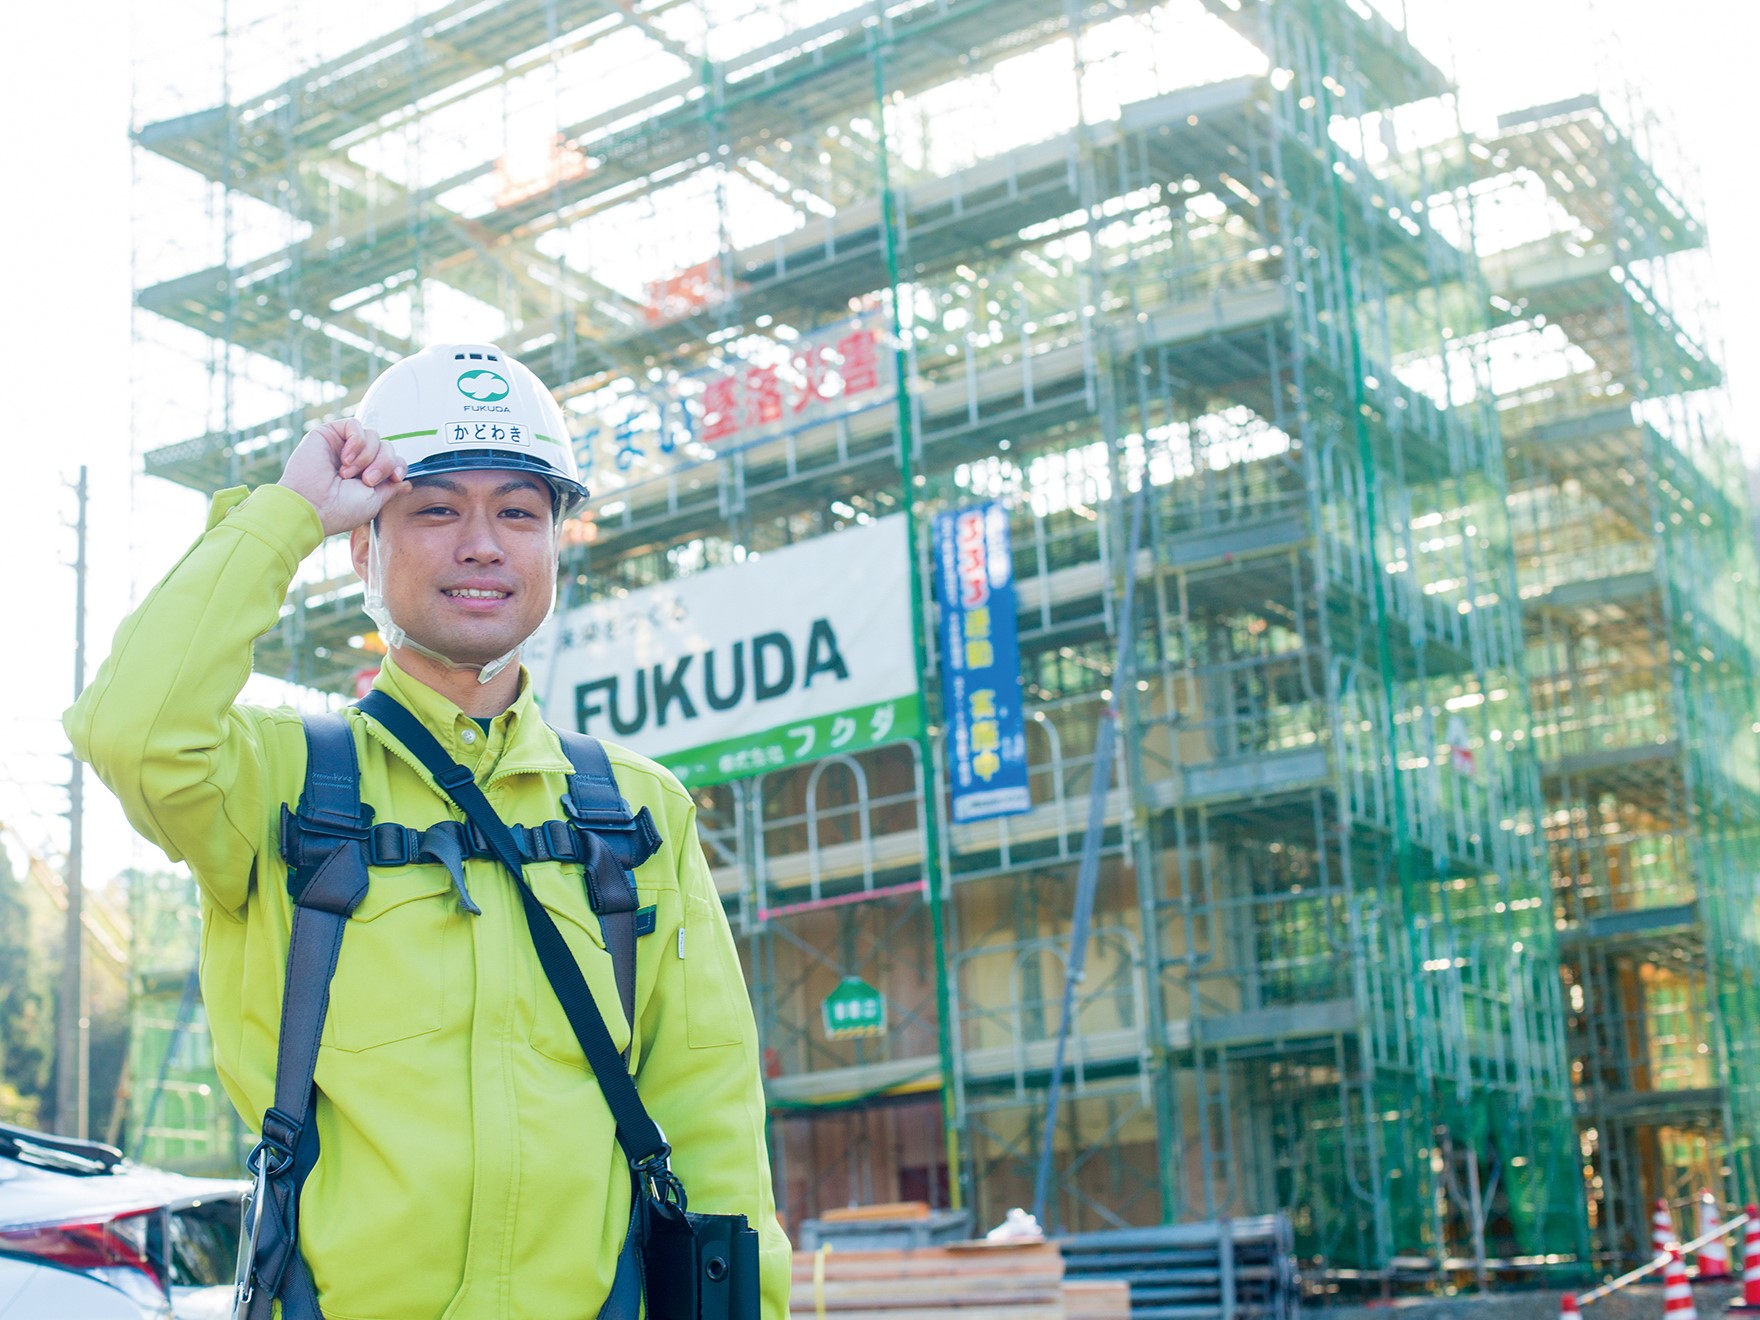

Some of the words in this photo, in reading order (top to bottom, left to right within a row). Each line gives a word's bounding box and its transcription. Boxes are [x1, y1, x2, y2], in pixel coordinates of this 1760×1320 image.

[463, 404, 511, 414] FUKUDA
[454, 423, 522, 443] かどわき
[574, 615, 850, 736] FUKUDA
